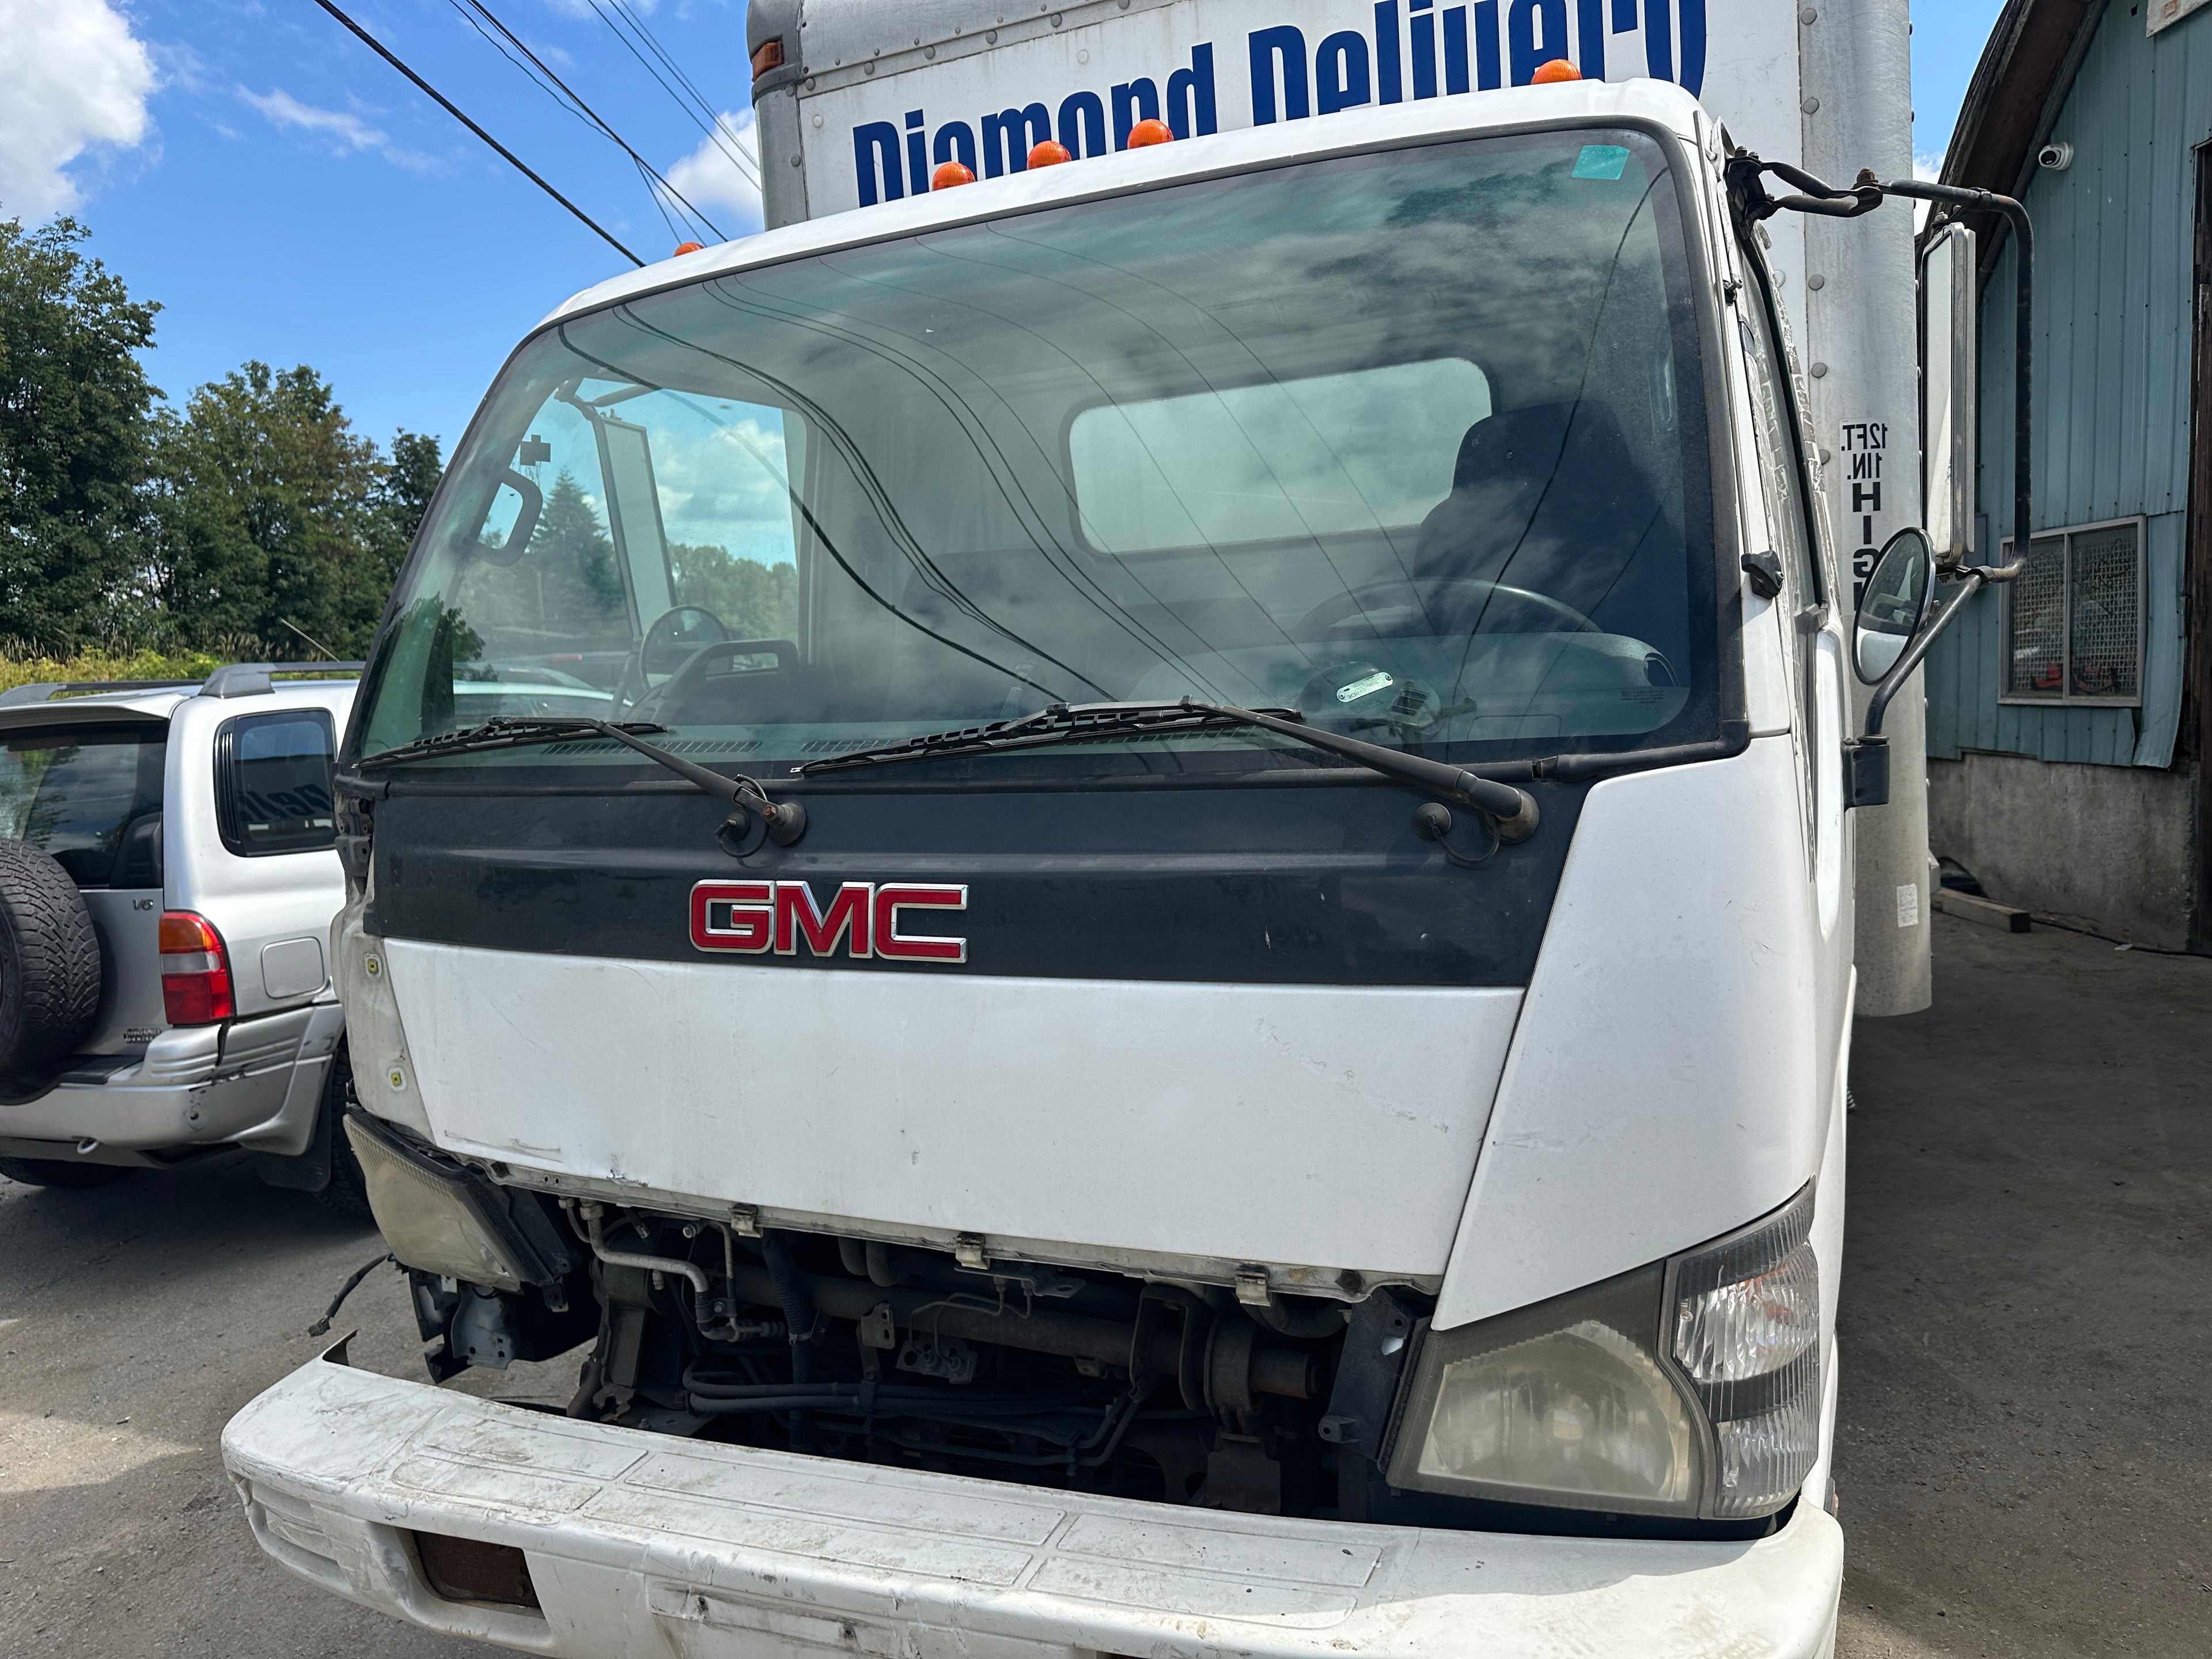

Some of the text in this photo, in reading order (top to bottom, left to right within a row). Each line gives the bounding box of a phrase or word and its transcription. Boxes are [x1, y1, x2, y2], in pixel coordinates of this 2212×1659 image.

[853, 0, 1706, 207] Diamond Delivery
[132, 899, 154, 911] V6
[690, 879, 969, 964] GMC
